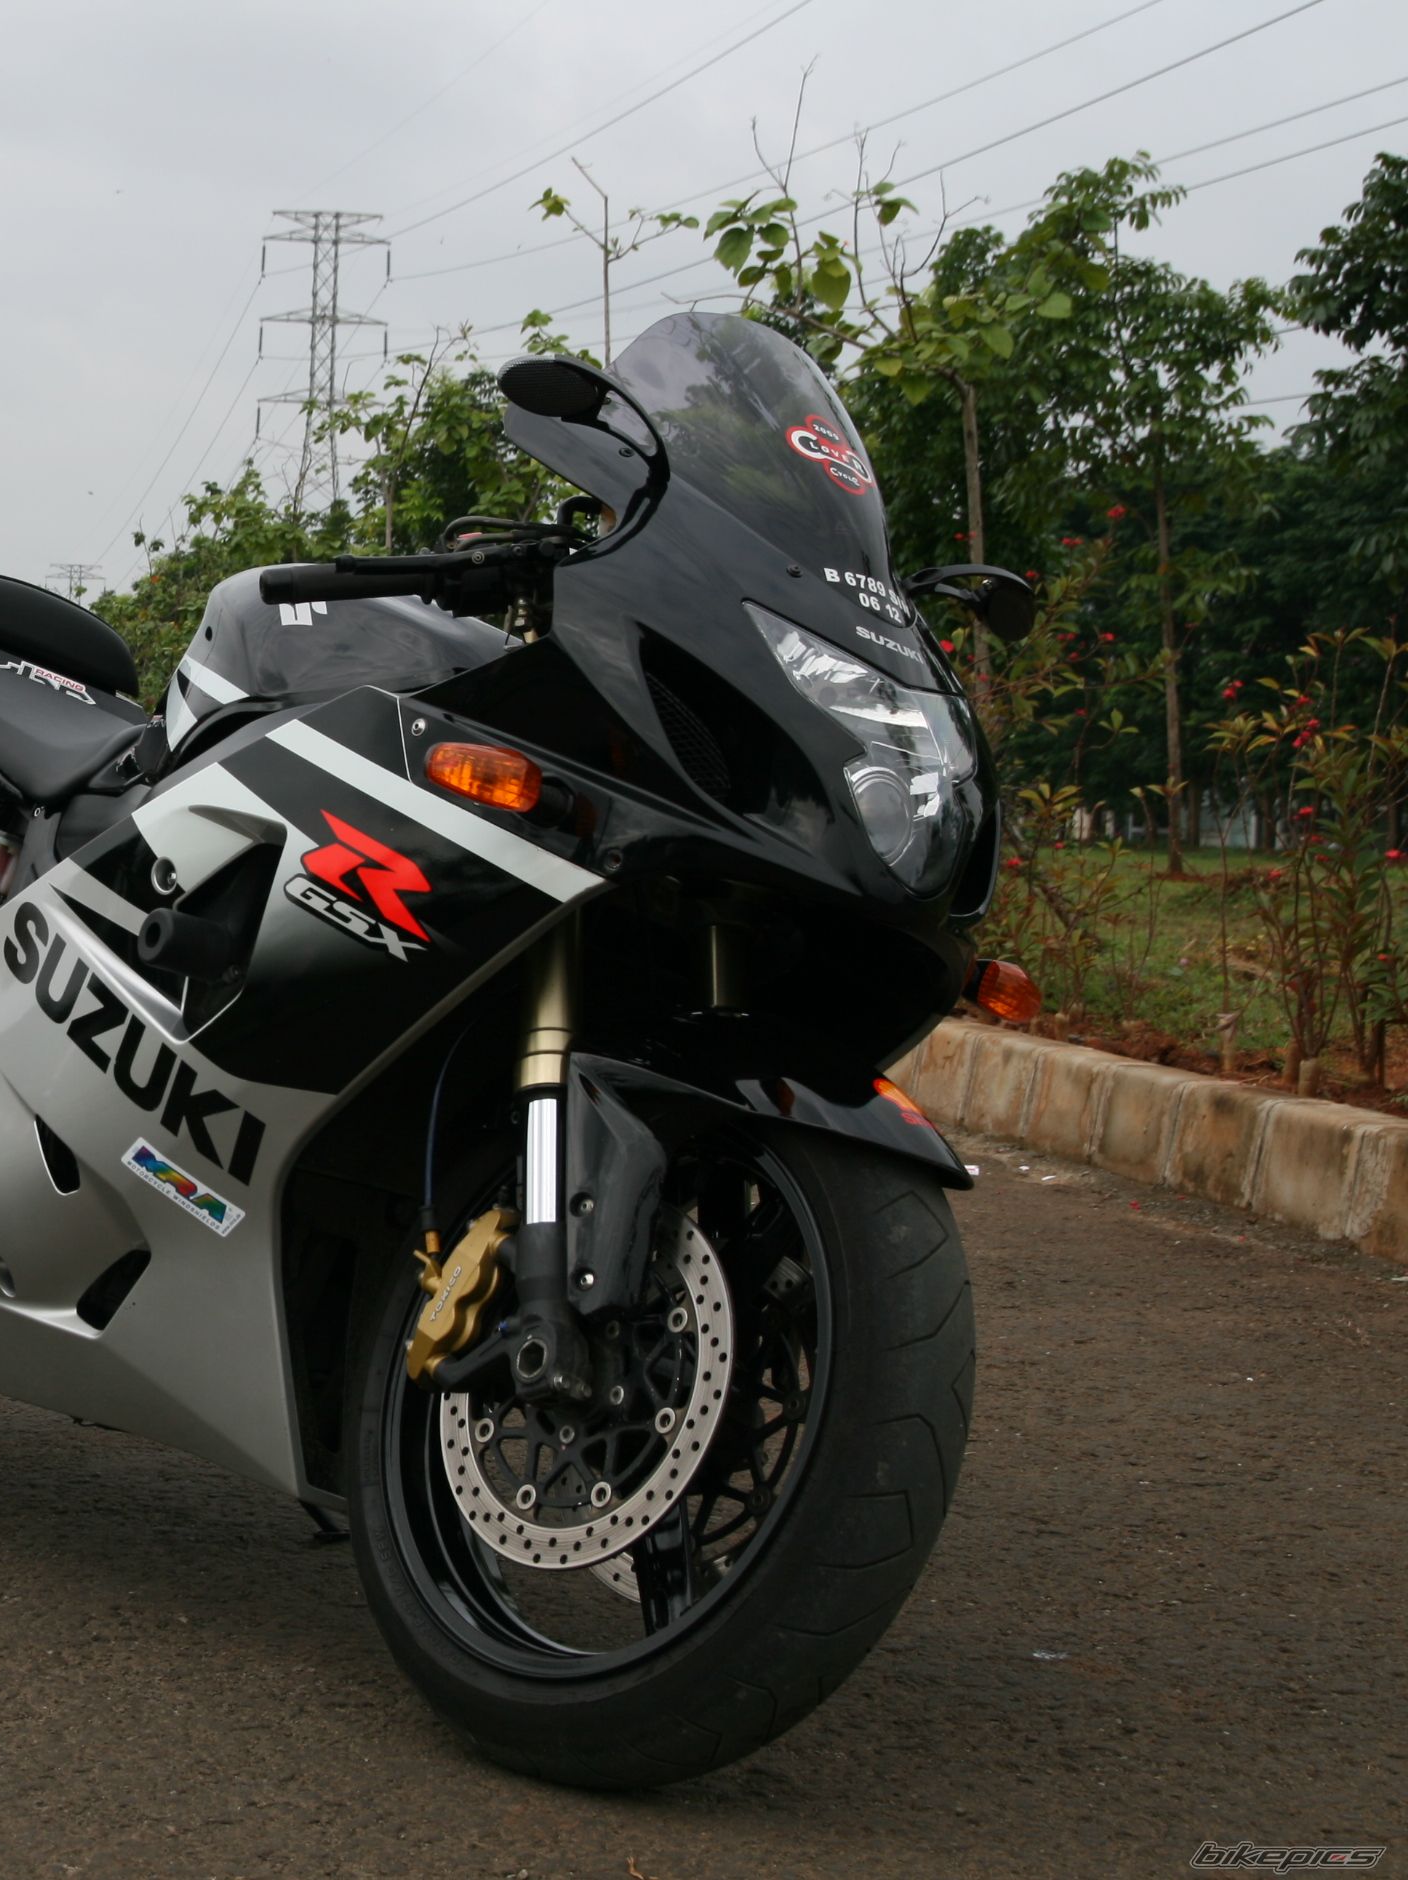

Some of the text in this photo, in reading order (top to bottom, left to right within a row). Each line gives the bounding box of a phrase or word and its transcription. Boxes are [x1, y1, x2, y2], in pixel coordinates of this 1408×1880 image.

[823, 567, 841, 583] B
[844, 571, 887, 597] 6789
[858, 592, 903, 624] 06 12
[855, 625, 924, 664] SUZUKI
[34, 667, 86, 692] RACING
[3, 901, 267, 1187] SUZUKI
[126, 1160, 171, 1195] MOTORCYCLE
[429, 1265, 462, 1322] TOKICO
